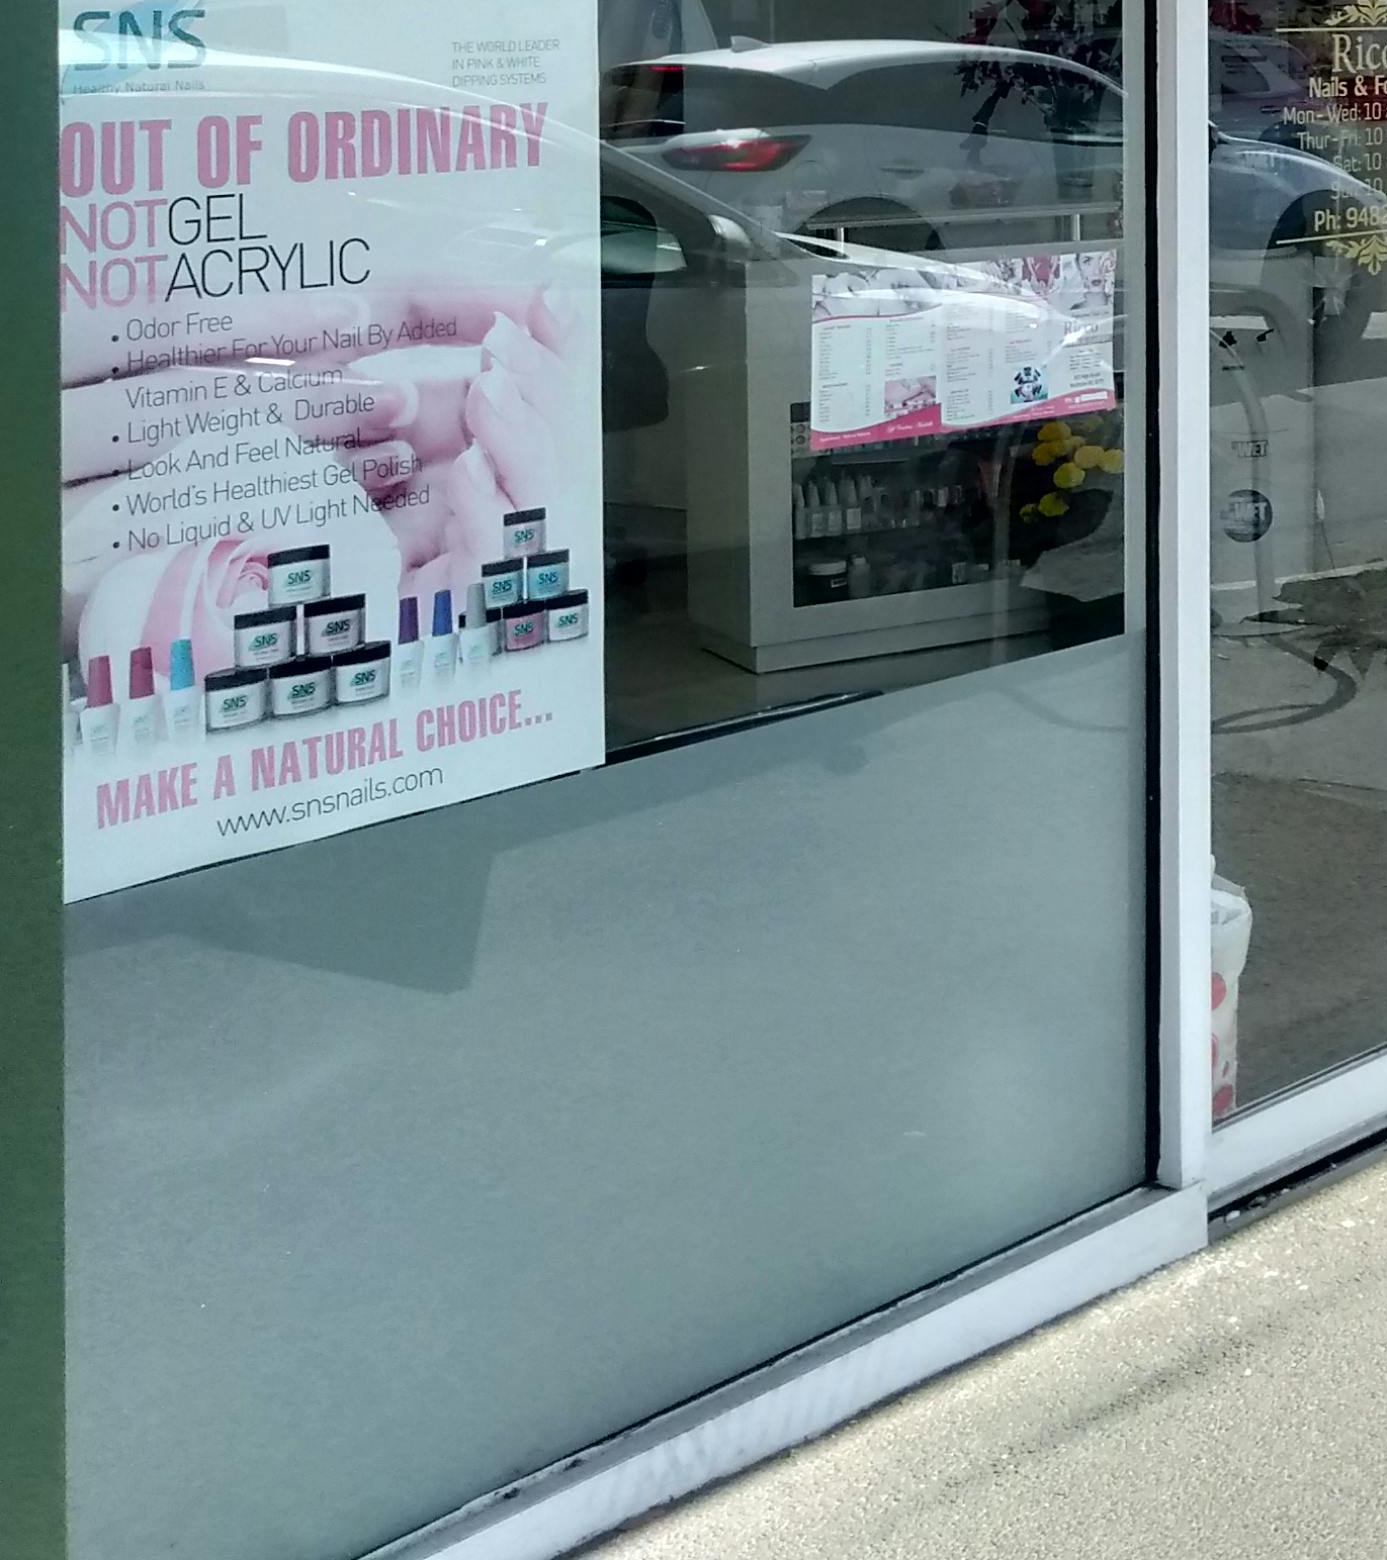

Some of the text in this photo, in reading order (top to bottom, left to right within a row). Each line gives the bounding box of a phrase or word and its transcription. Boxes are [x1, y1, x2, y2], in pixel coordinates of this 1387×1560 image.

[73, 8, 207, 72] SNS
[452, 39, 560, 53] THE WORLD LEADER
[464, 56, 540, 70] PINK WHITE
[452, 73, 547, 88] DIPPING SYSTEMS
[1309, 74, 1368, 98] Nails &
[1364, 102, 1381, 120] 10
[60, 102, 548, 198] OUT OF ORDINARY
[1365, 127, 1382, 145] 10
[1314, 209, 1341, 232] Ph:
[127, 313, 233, 342] Odor Free
[127, 318, 457, 372] Healthier For Your Nail By Added
[126, 369, 344, 410] Vitamin E & Calcium
[127, 393, 375, 447] Light Weight & Durable
[127, 427, 362, 481] Look And Feel Natural
[127, 454, 423, 517] World's Healthiest Gel Polish
[128, 485, 431, 551] No Liquid & UV Light Needed
[96, 764, 198, 830] MAKE
[213, 754, 237, 800] A
[250, 722, 404, 792] NATURAL
[217, 764, 444, 838] www.snsnails.com
